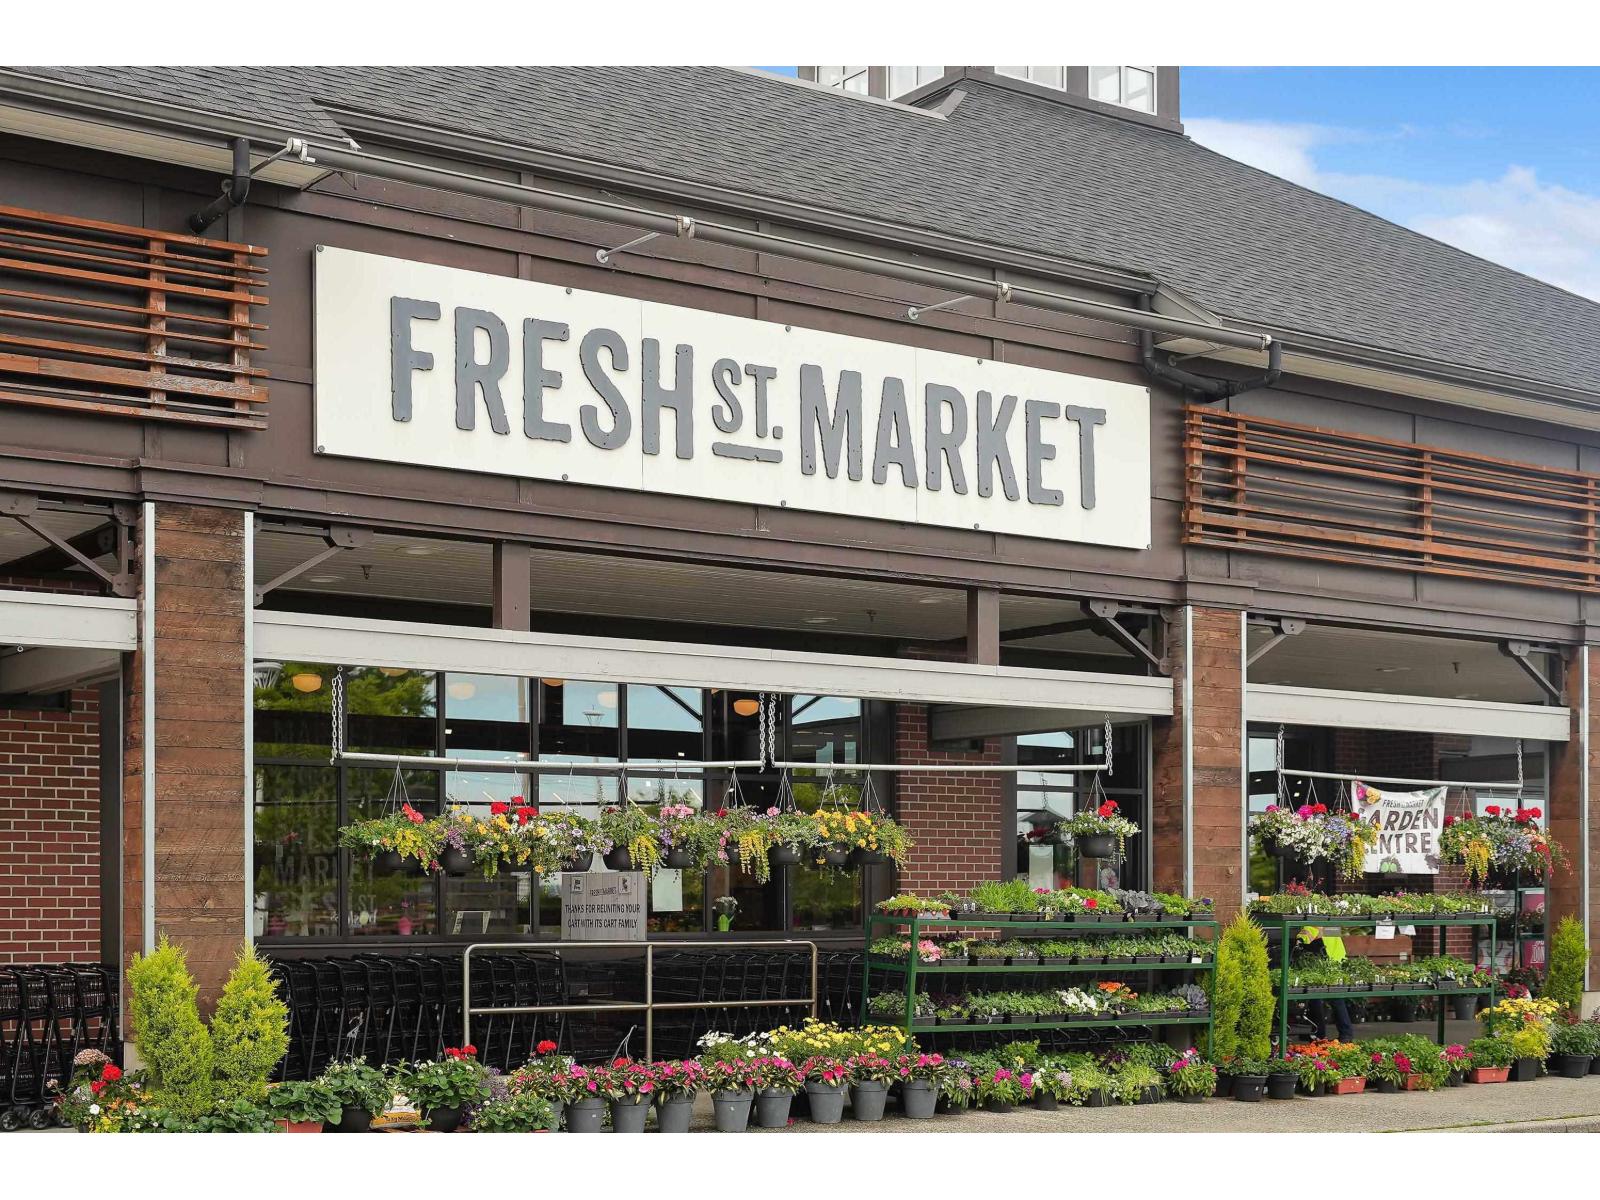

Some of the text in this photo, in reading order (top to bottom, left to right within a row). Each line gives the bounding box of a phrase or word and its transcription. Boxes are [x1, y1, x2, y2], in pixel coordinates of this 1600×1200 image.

[390, 296, 694, 460] FRESH
[800, 364, 1107, 510] MARKET
[1359, 807, 1438, 831] ARDEN
[1365, 832, 1432, 854] NTRE
[565, 903, 641, 913] THANKS FOR REUNITING YOUR
[567, 918, 638, 928] CART WITH ITS CART FAMILY
